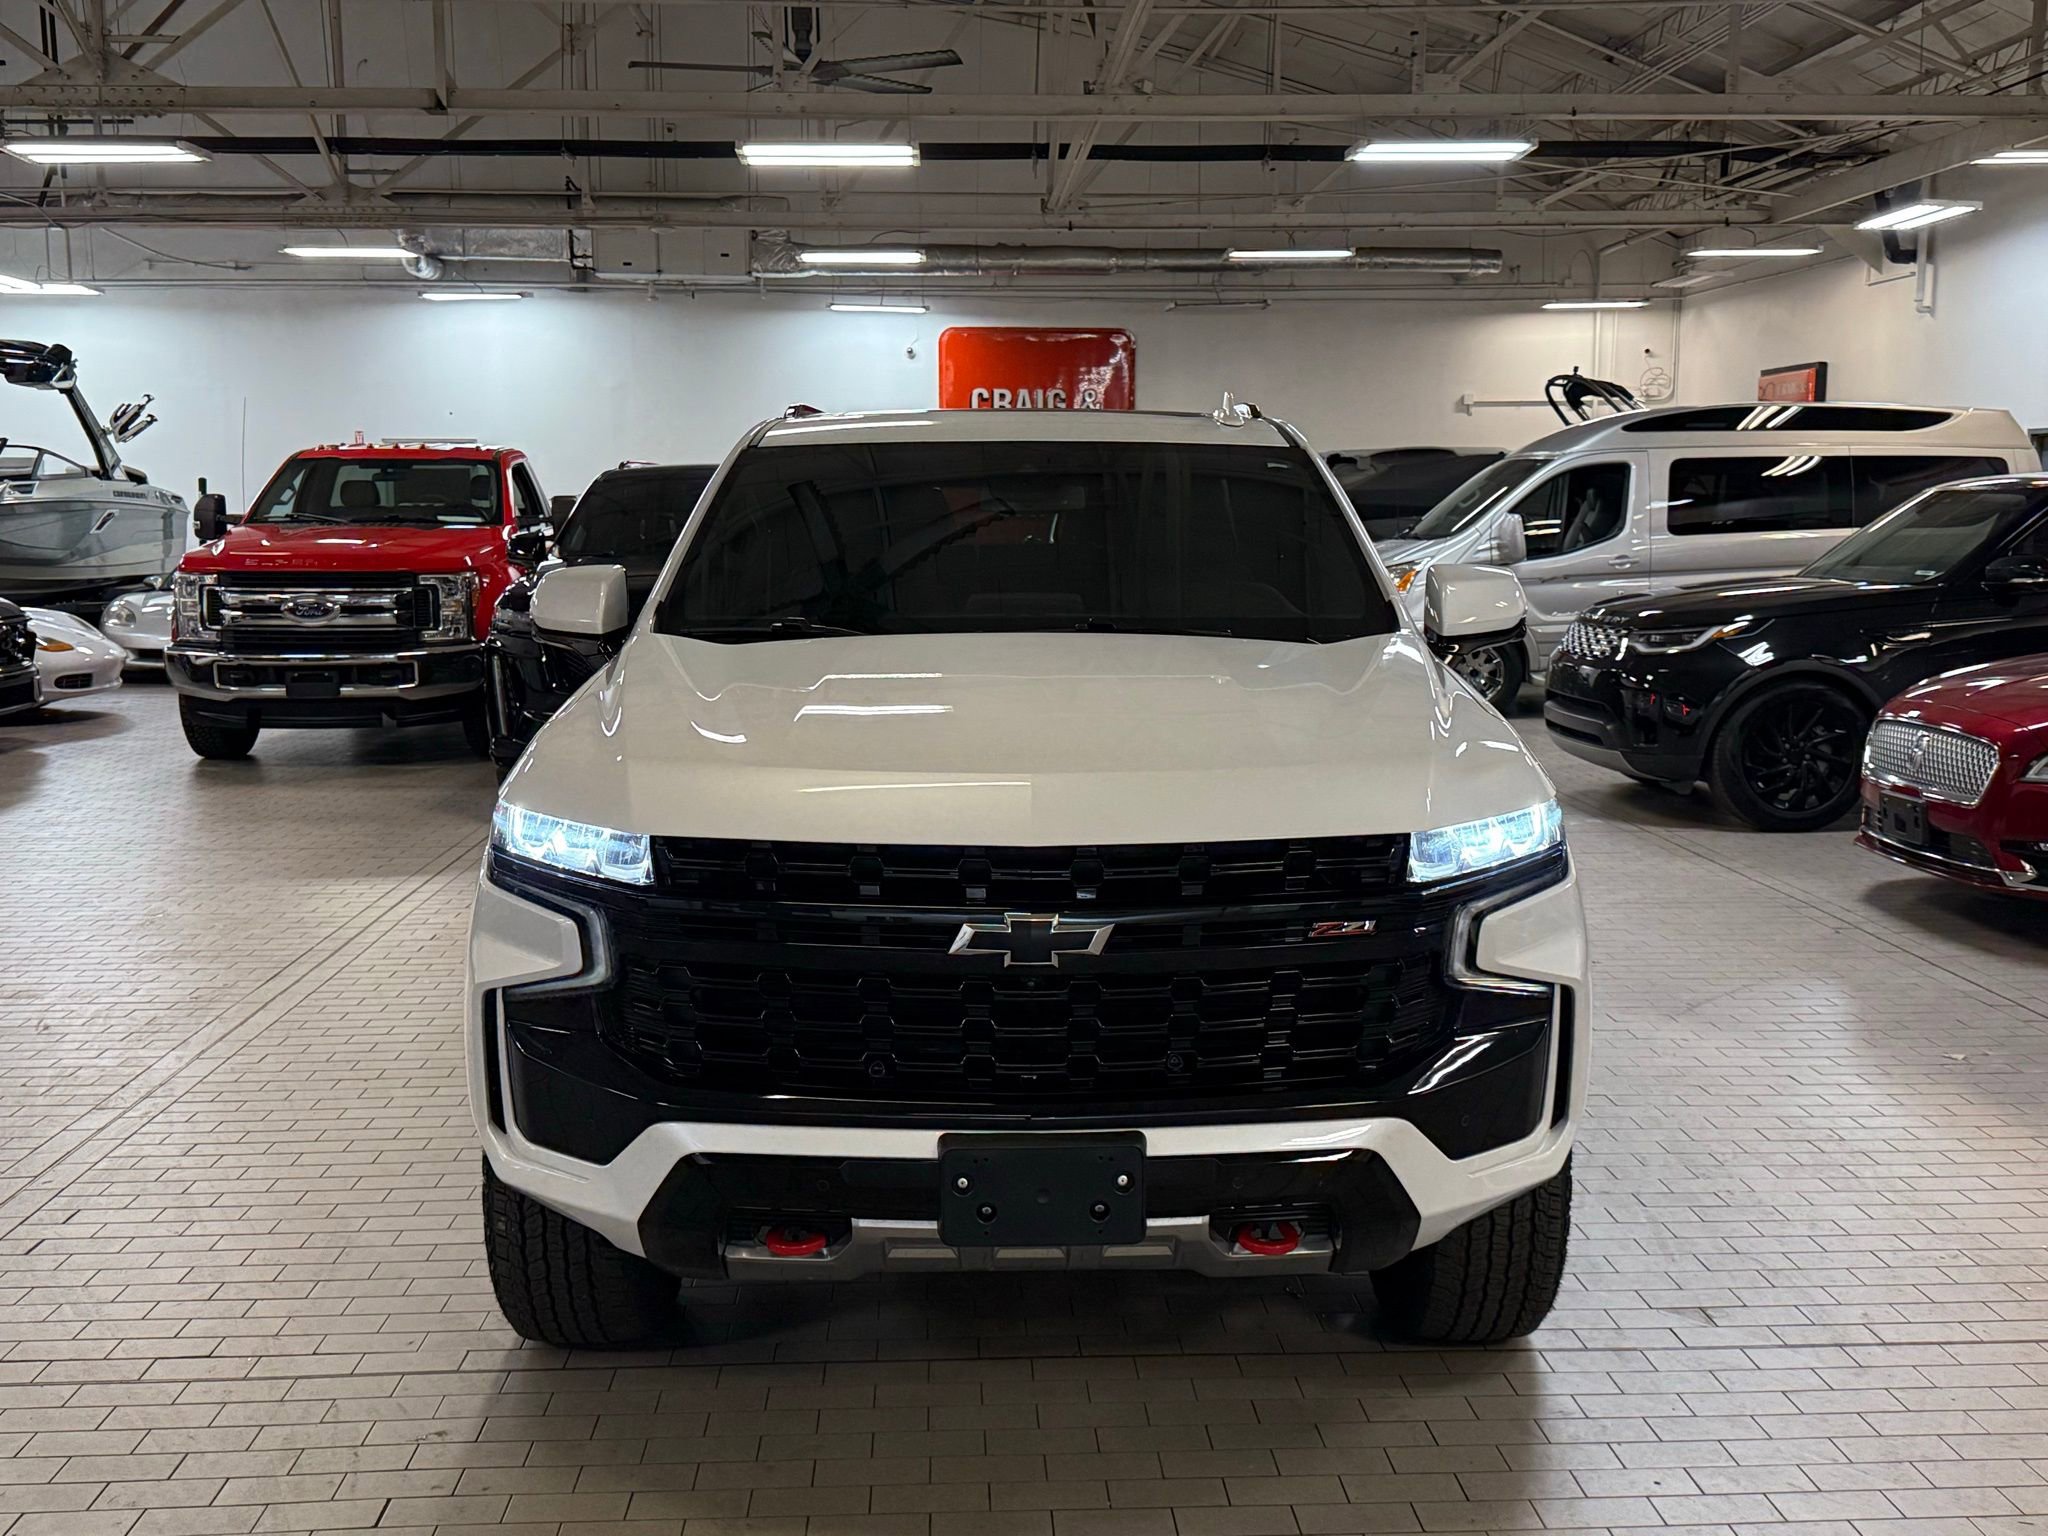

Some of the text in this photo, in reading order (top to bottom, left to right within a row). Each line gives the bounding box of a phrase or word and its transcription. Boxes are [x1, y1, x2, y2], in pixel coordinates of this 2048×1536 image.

[970, 388, 1103, 409] CRAIG &
[1308, 920, 1377, 937] Z71
